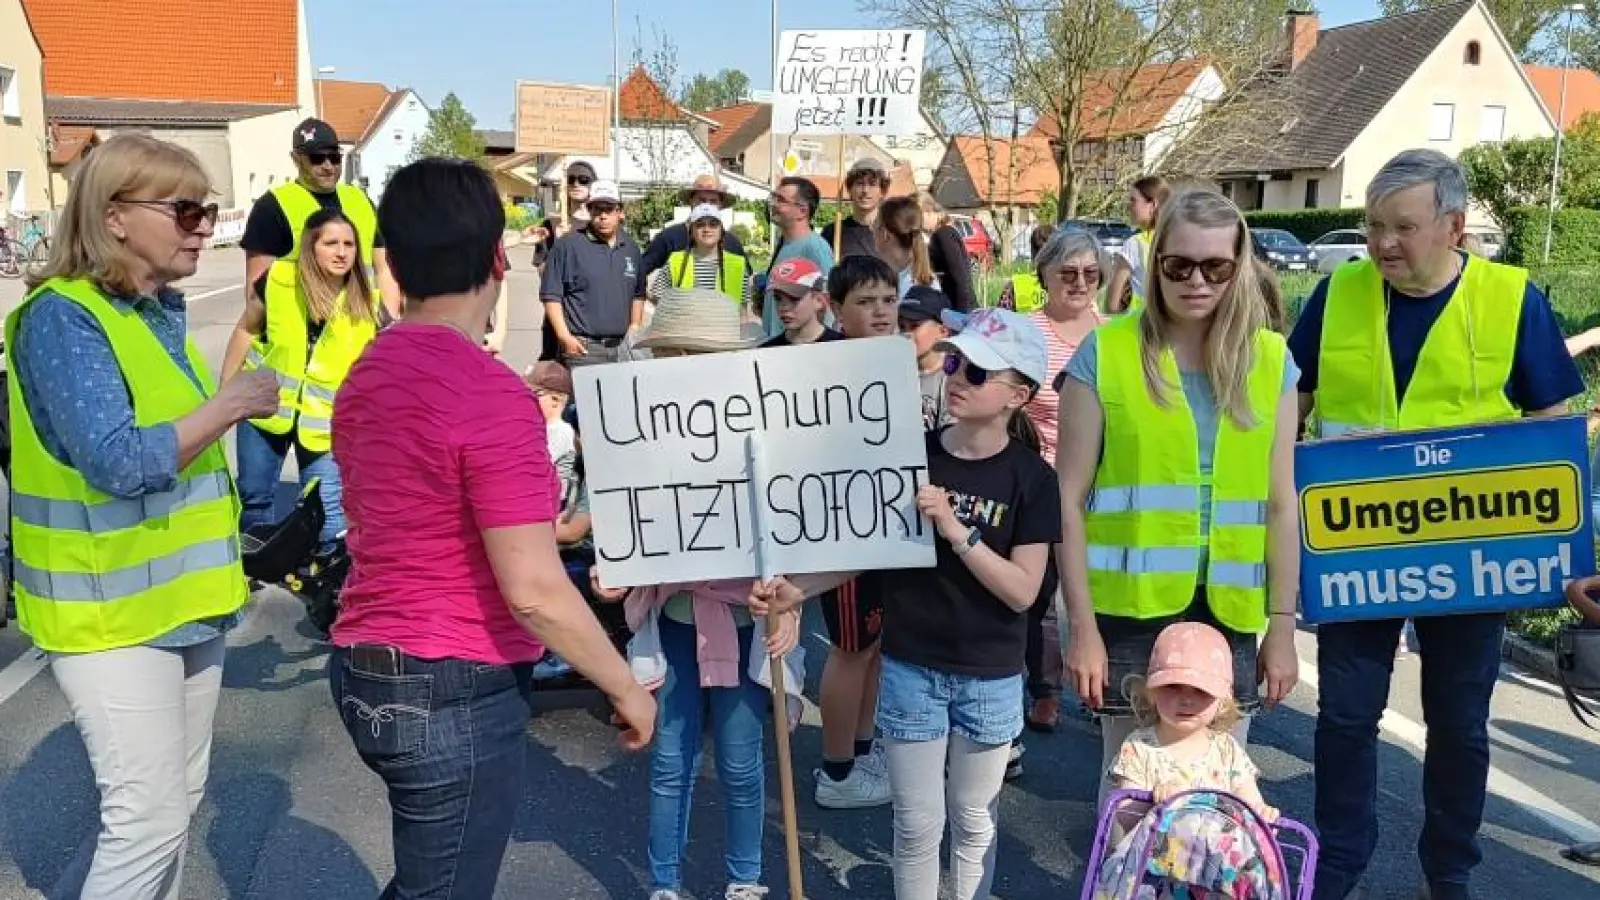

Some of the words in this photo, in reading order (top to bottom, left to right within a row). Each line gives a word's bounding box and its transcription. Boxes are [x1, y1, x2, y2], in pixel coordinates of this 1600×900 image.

[787, 33, 826, 62] Es
[780, 65, 915, 95] UMGEHUNG
[795, 97, 846, 131] jetzt
[596, 360, 891, 462] Umgehung
[1414, 444, 1452, 467] Die
[593, 478, 751, 562] JETZT
[767, 465, 927, 545] SOFORT
[1321, 486, 1560, 535] Umgehung
[1320, 562, 1456, 608] muss
[1471, 542, 1571, 598] her!
